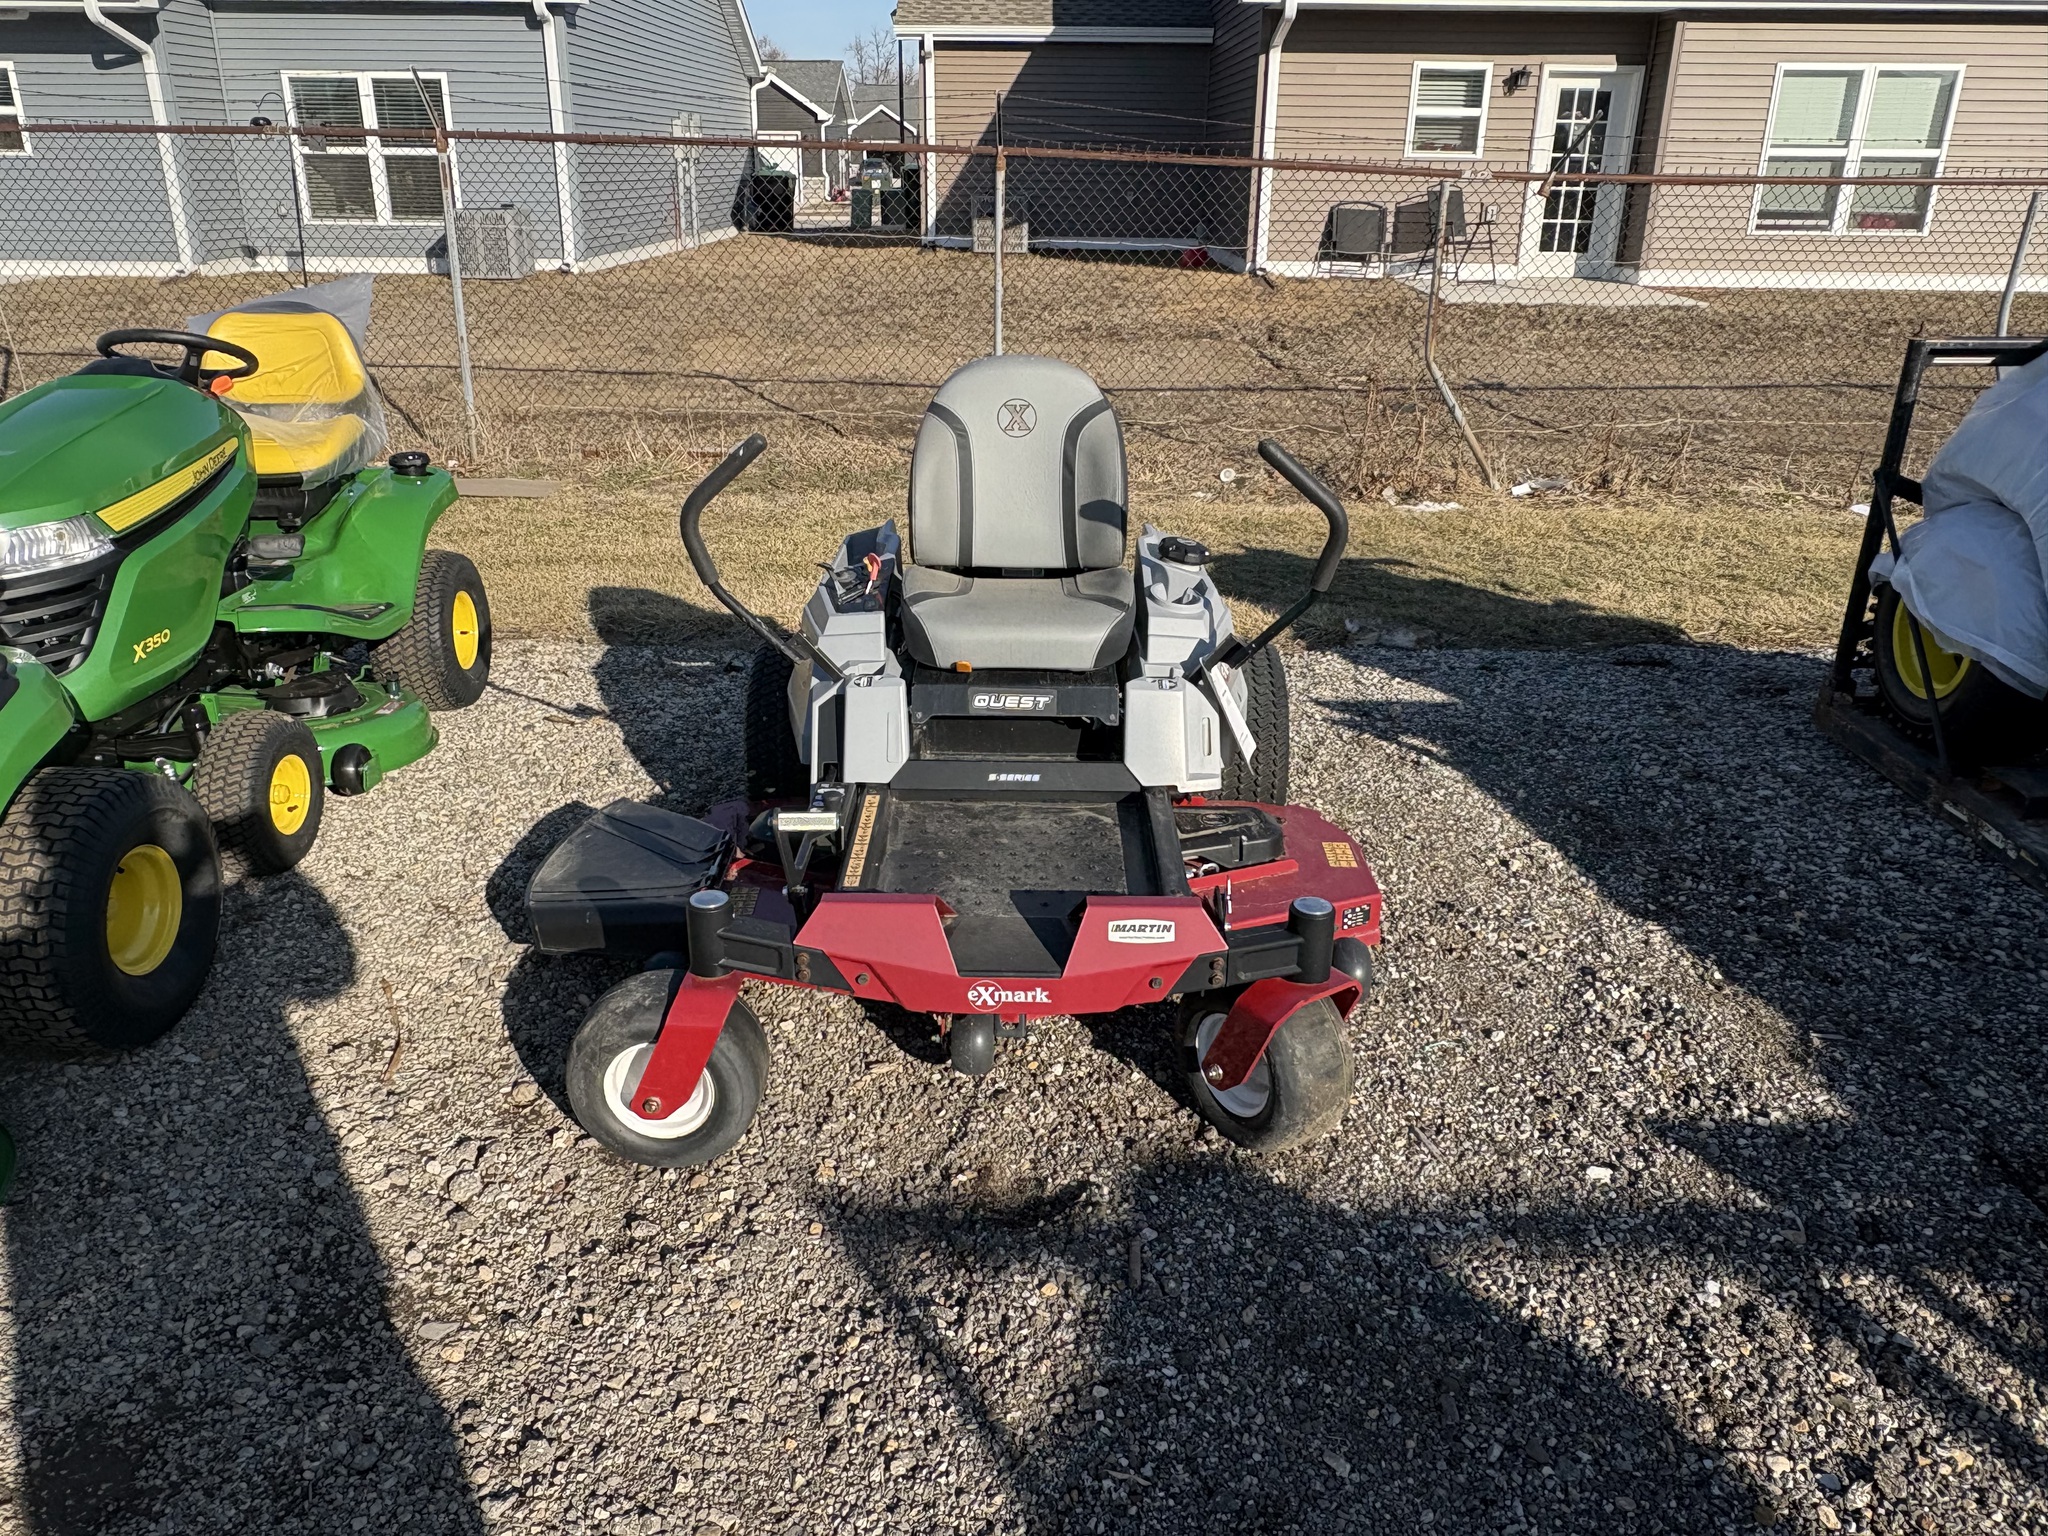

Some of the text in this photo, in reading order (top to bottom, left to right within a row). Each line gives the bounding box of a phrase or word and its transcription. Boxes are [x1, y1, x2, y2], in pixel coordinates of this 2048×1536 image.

[1003, 404, 1031, 431] X
[191, 446, 228, 485] JOHN DEERE
[133, 628, 171, 664] X350
[972, 693, 1054, 711] QUEST
[1110, 924, 1173, 933] MARTIN
